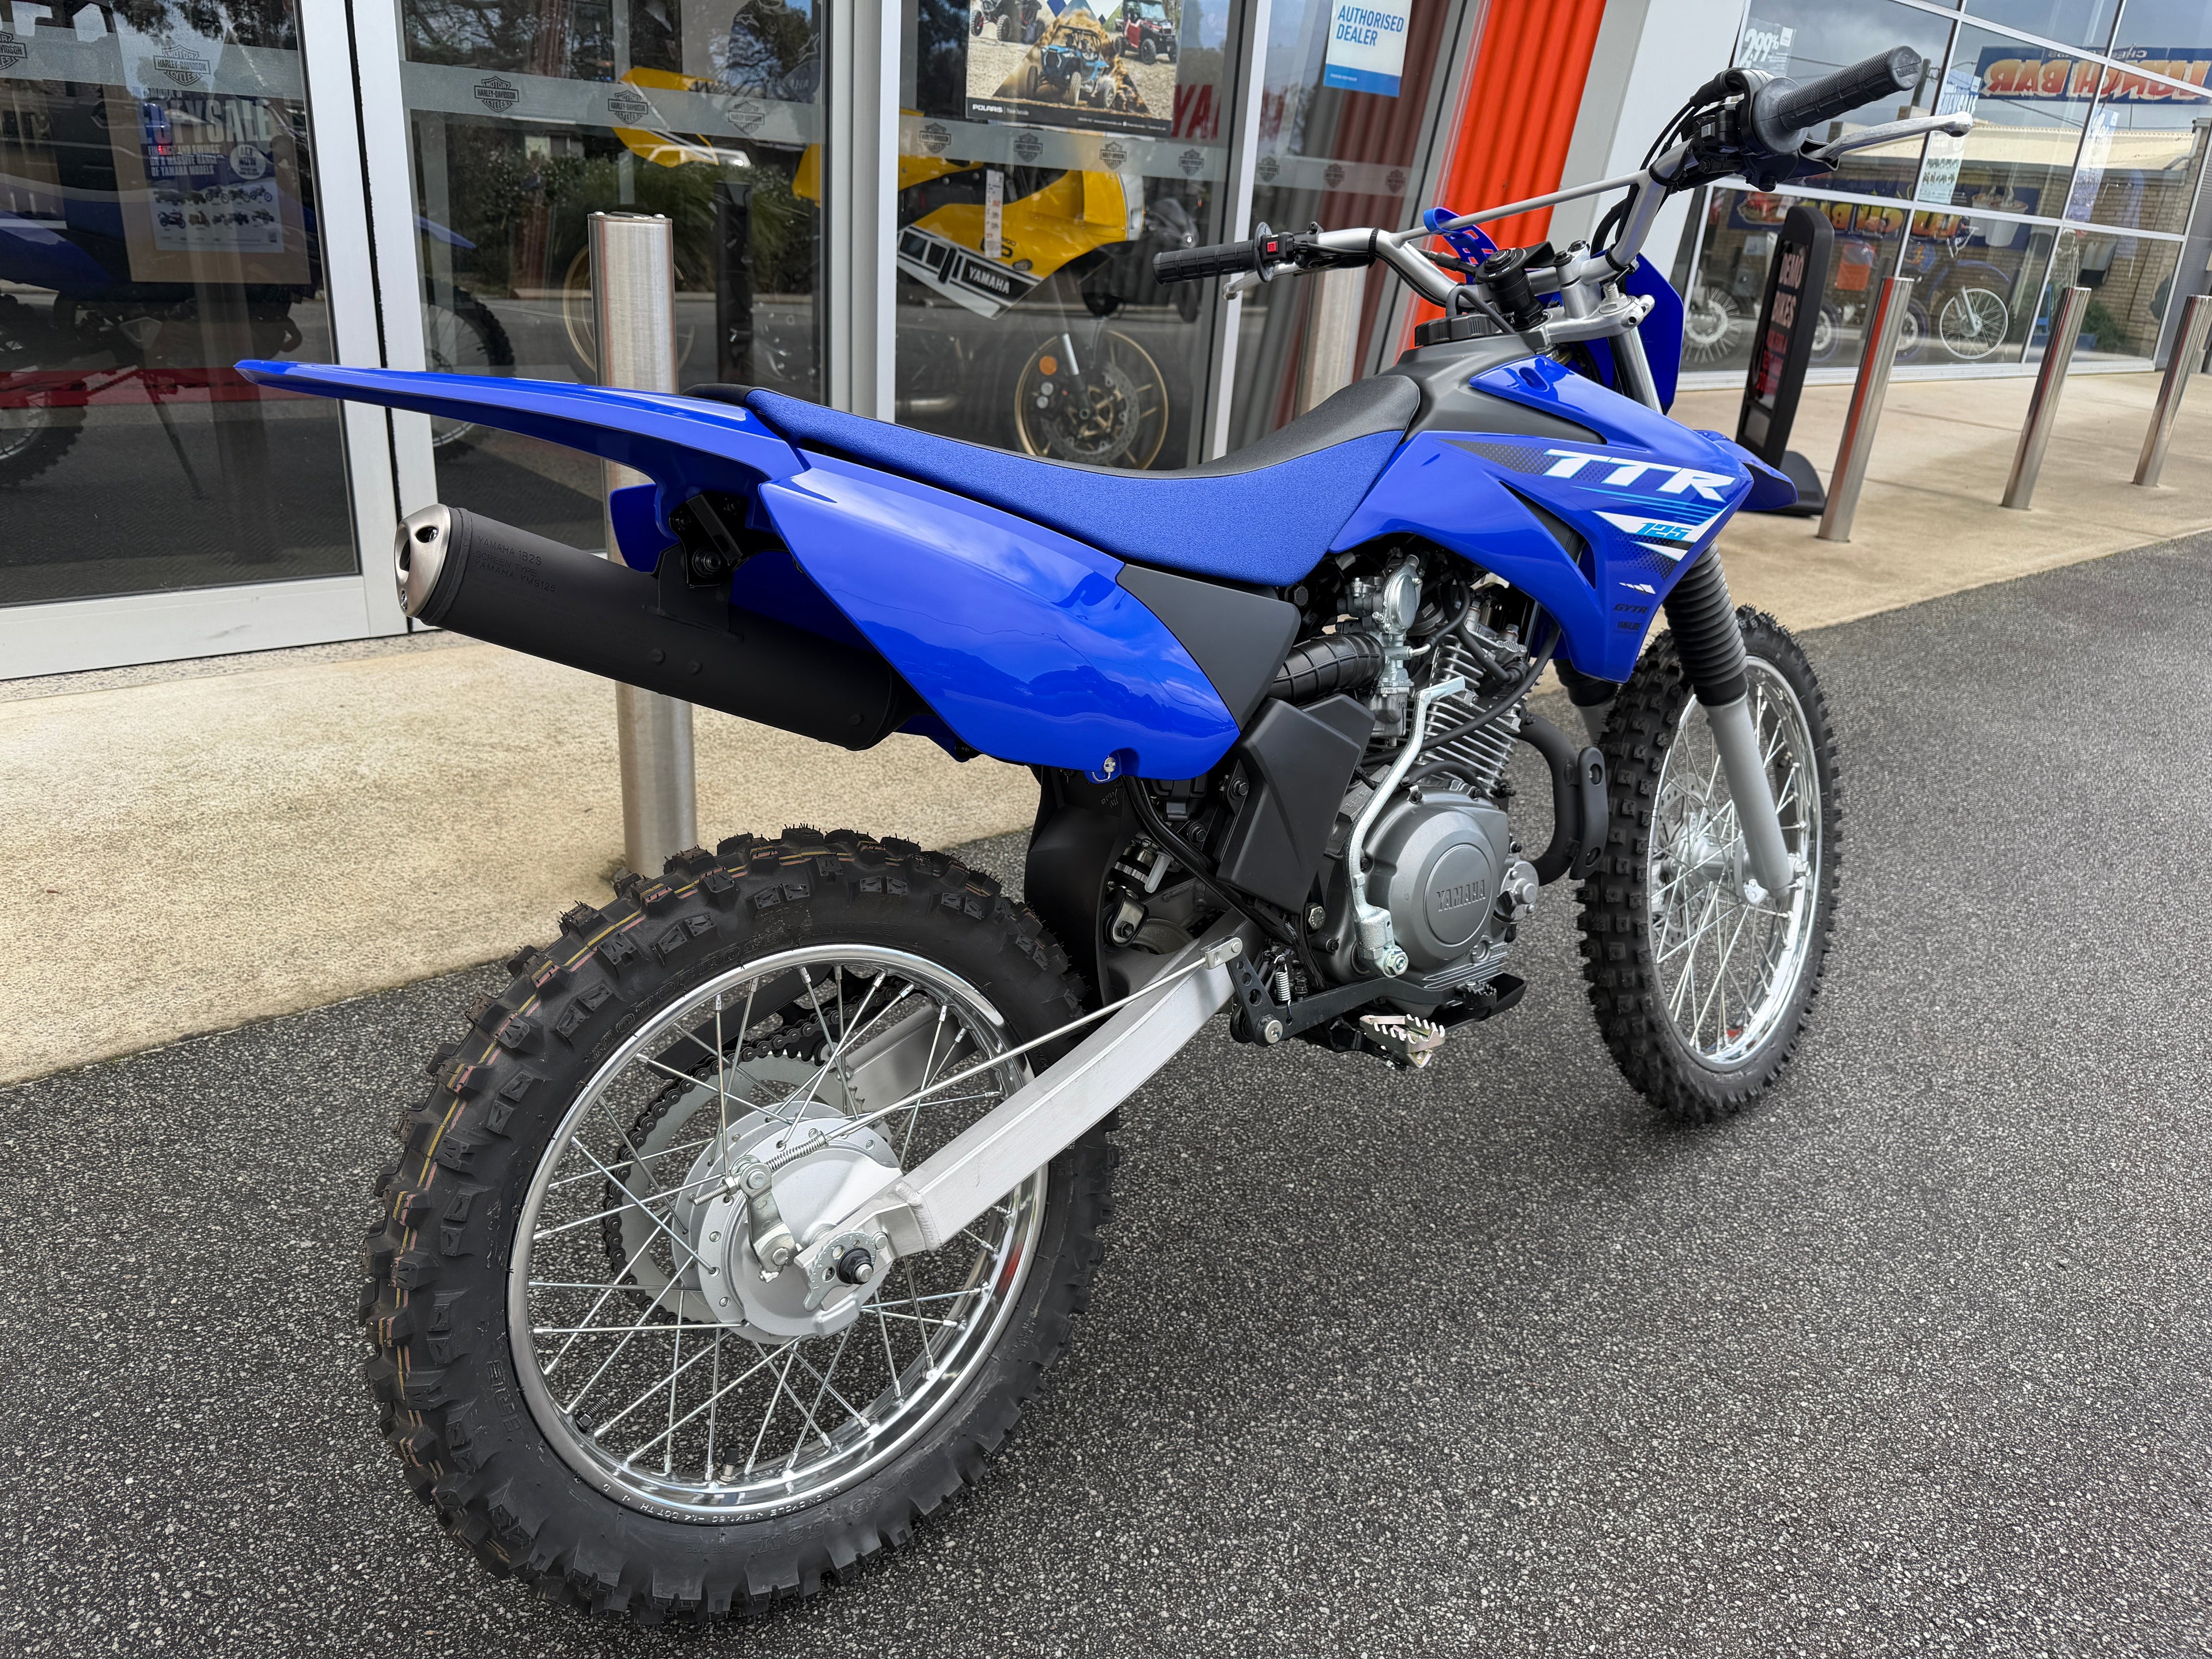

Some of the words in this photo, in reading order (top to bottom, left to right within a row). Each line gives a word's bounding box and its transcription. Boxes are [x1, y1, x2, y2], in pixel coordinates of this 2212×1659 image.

[1338, 5, 1404, 32] AUTHORISED
[1336, 24, 1378, 46] DEALER
[157, 59, 207, 71] HARLEY-DAVIDSON
[477, 89, 516, 100] HARLEY-DAVIDSON
[972, 104, 1003, 113] POLARIS
[969, 265, 1010, 294] YAMAHA
[1779, 252, 1805, 289] DEMO
[1771, 291, 1797, 329] BIKES
[1543, 449, 1736, 503] TTR
[1637, 522, 1692, 540] 125
[478, 536, 515, 557] YAMAHA
[518, 550, 543, 566] 1B2S
[474, 559, 515, 579] YAMAHA
[475, 551, 512, 567] SCREEN
[514, 563, 537, 577] TYPE
[1615, 603, 1649, 614] GYTR
[1436, 879, 1486, 912] YAMAHA
[639, 1502, 655, 1513] TH
[770, 1501, 805, 1517] CYCLE
